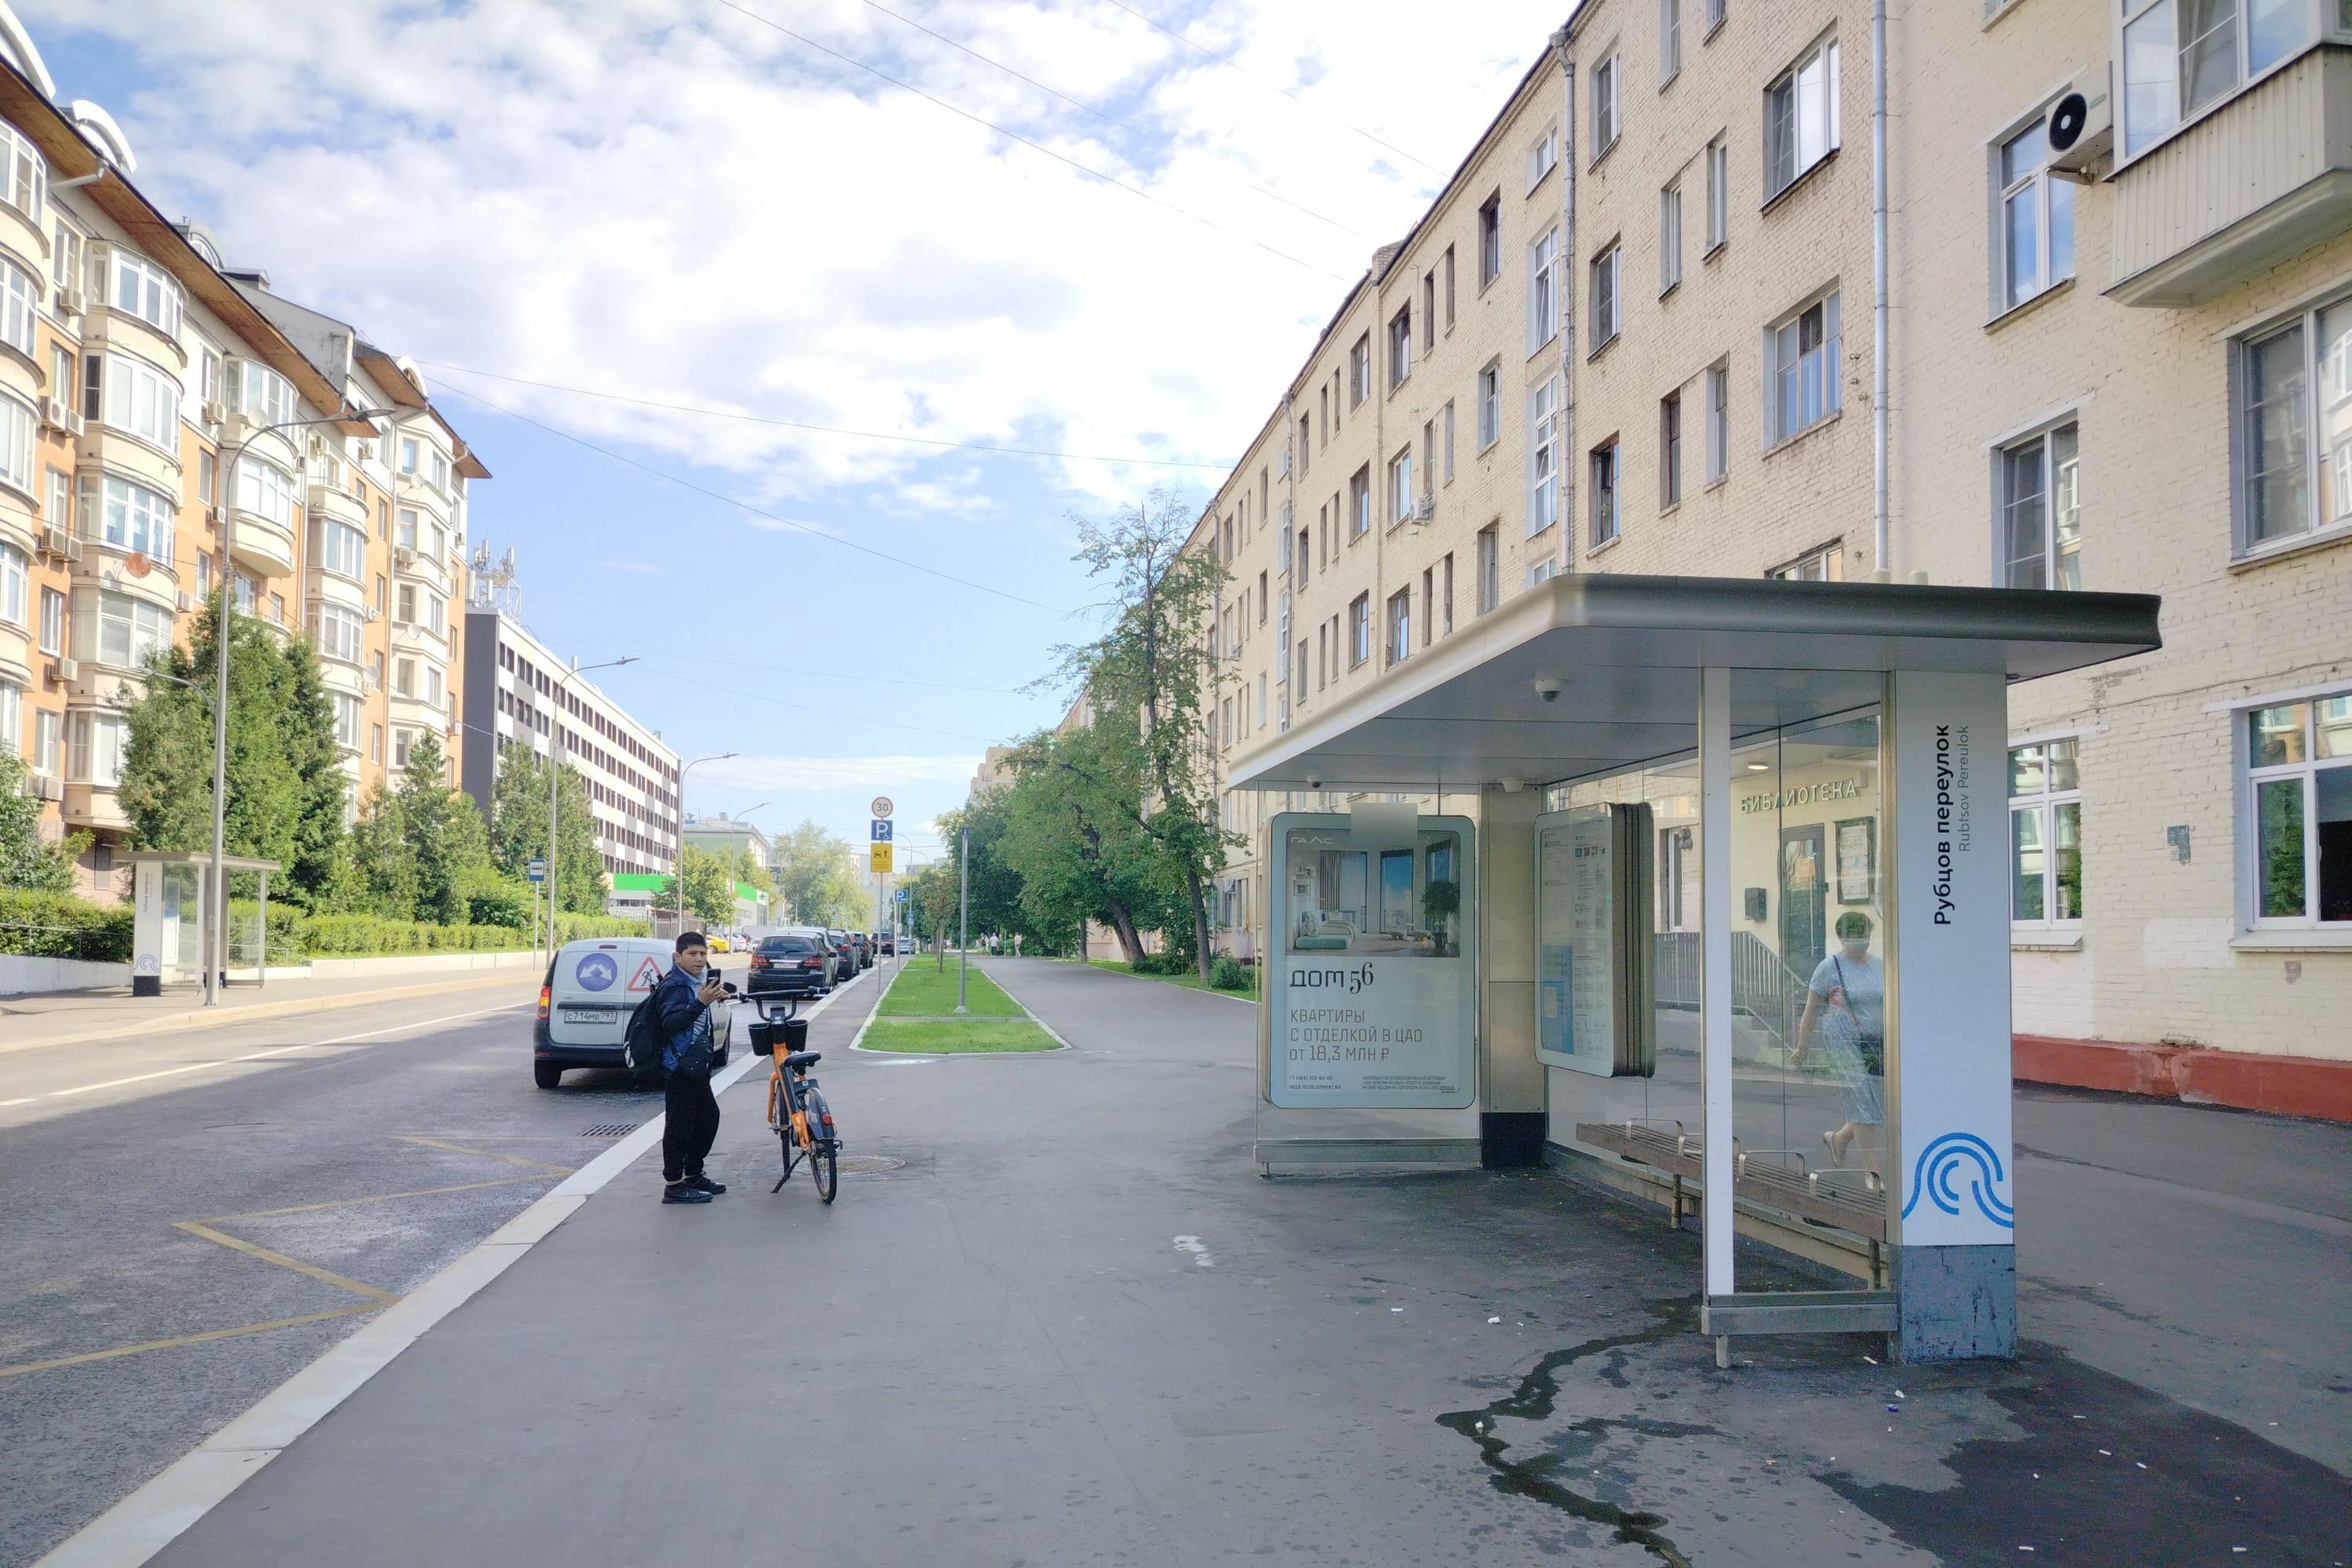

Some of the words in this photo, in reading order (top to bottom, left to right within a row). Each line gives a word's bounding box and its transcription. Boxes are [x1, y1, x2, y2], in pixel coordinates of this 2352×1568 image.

[1957, 724, 1969, 788] Pereulok
[1936, 724, 1954, 833] переулок
[876, 802, 888, 812] 30
[1740, 779, 1857, 814] БИБЛИОТЕКА
[1958, 794, 1969, 852] Rubtsov
[1933, 840, 1955, 925] Рубцов
[1349, 961, 1374, 995] 56
[1290, 1009, 1365, 1023] КВАРТИРЫ
[1290, 1028, 1299, 1042] С
[1304, 1025, 1377, 1044] ОТДЕЛКОЙ
[1382, 1029, 1391, 1042] В
[1396, 1029, 1423, 1044] ЦАО
[1289, 1048, 1305, 1061] от
[1309, 1045, 1341, 1063] 18,3
[1345, 1047, 1376, 1061] МЛН
